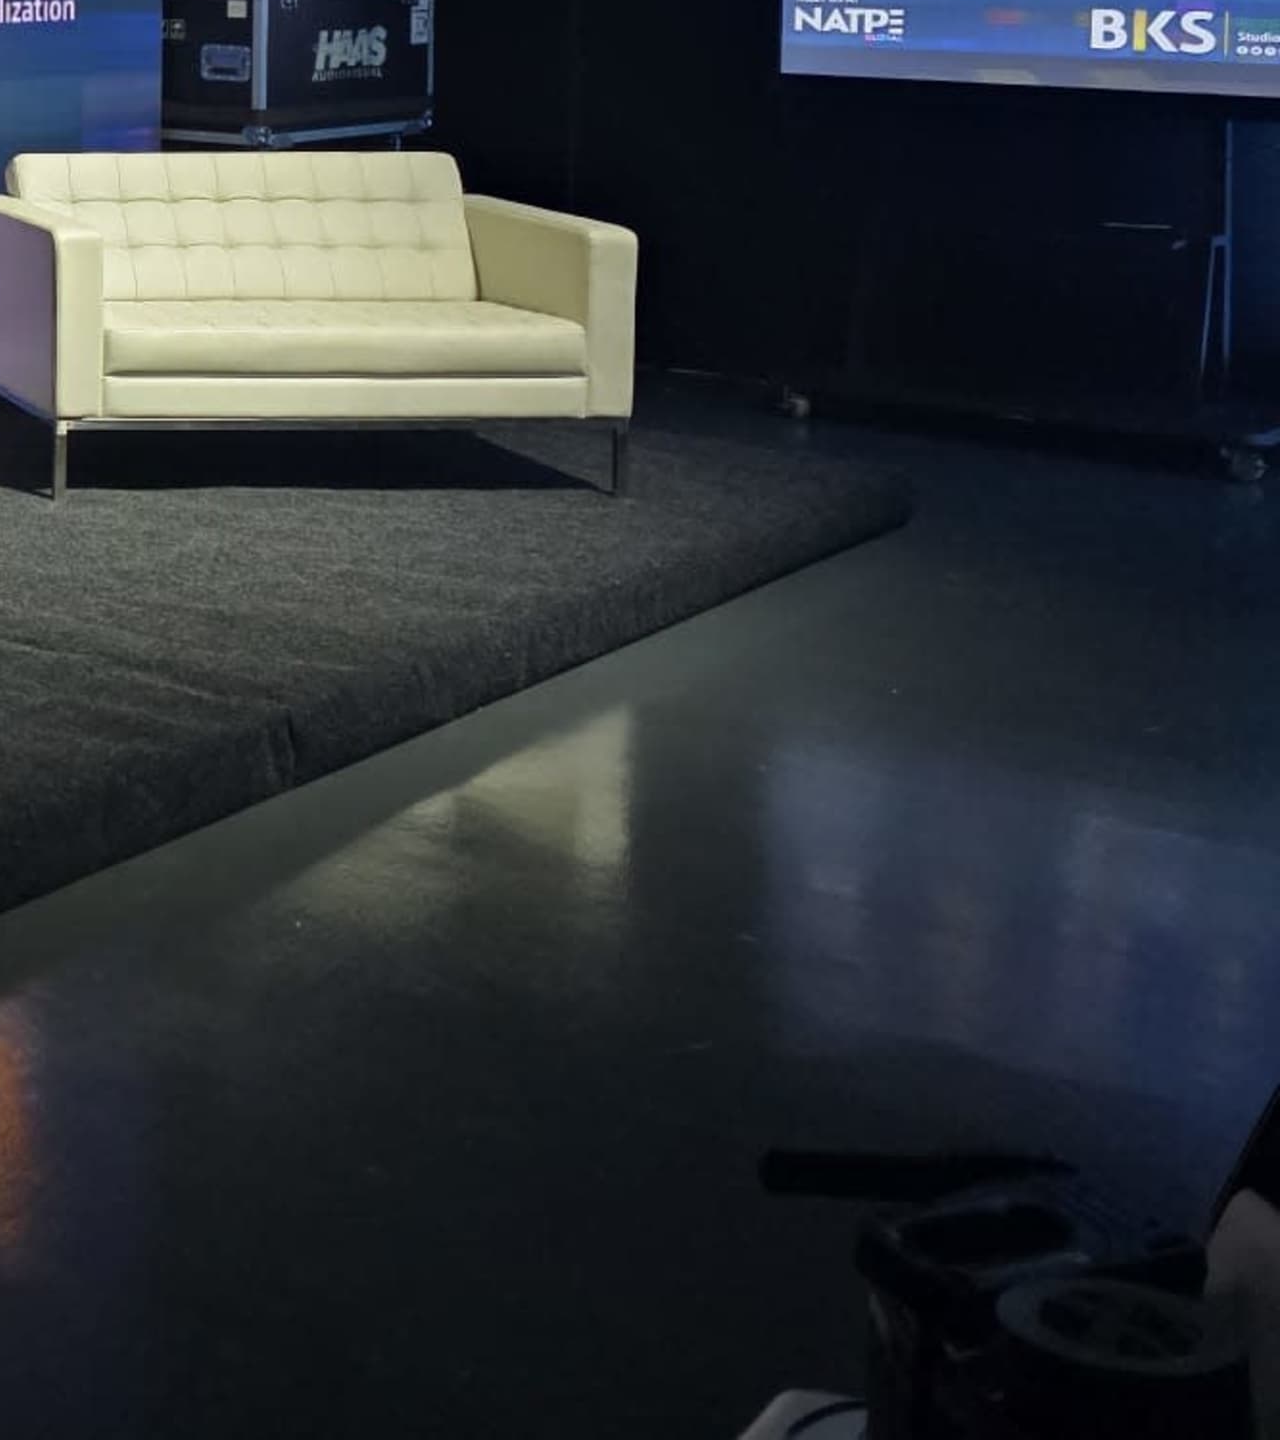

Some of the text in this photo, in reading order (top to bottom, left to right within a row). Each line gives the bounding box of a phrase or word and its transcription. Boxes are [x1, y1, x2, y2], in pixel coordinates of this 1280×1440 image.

[794, 6, 905, 35] NATPE
[1090, 8, 1217, 54] BKS
[315, 26, 387, 70] HAAS
